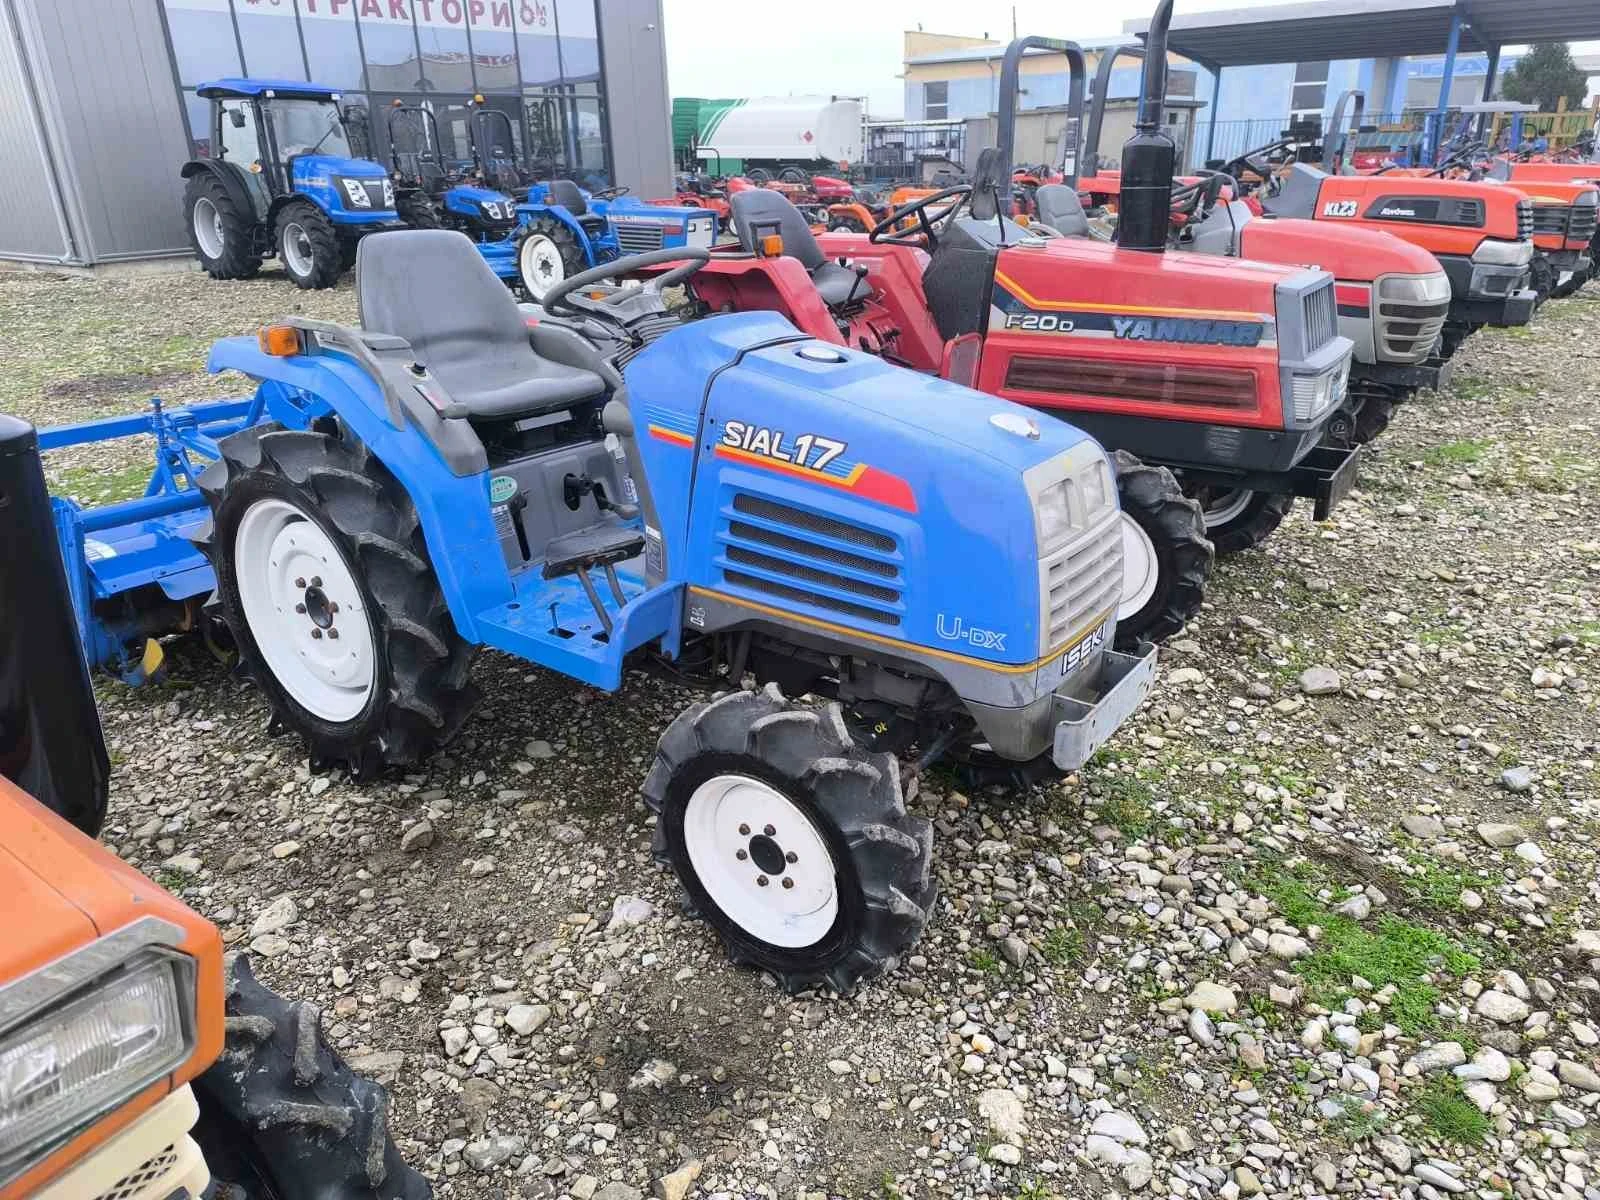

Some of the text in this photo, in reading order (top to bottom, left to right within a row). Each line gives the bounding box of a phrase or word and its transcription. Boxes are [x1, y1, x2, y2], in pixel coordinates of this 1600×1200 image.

[1323, 200, 1358, 217] KL23
[1006, 314, 1074, 332] F20D
[1111, 316, 1263, 347] YANMAR
[936, 613, 1008, 651] U-DX
[1061, 623, 1106, 676] ISEKI
